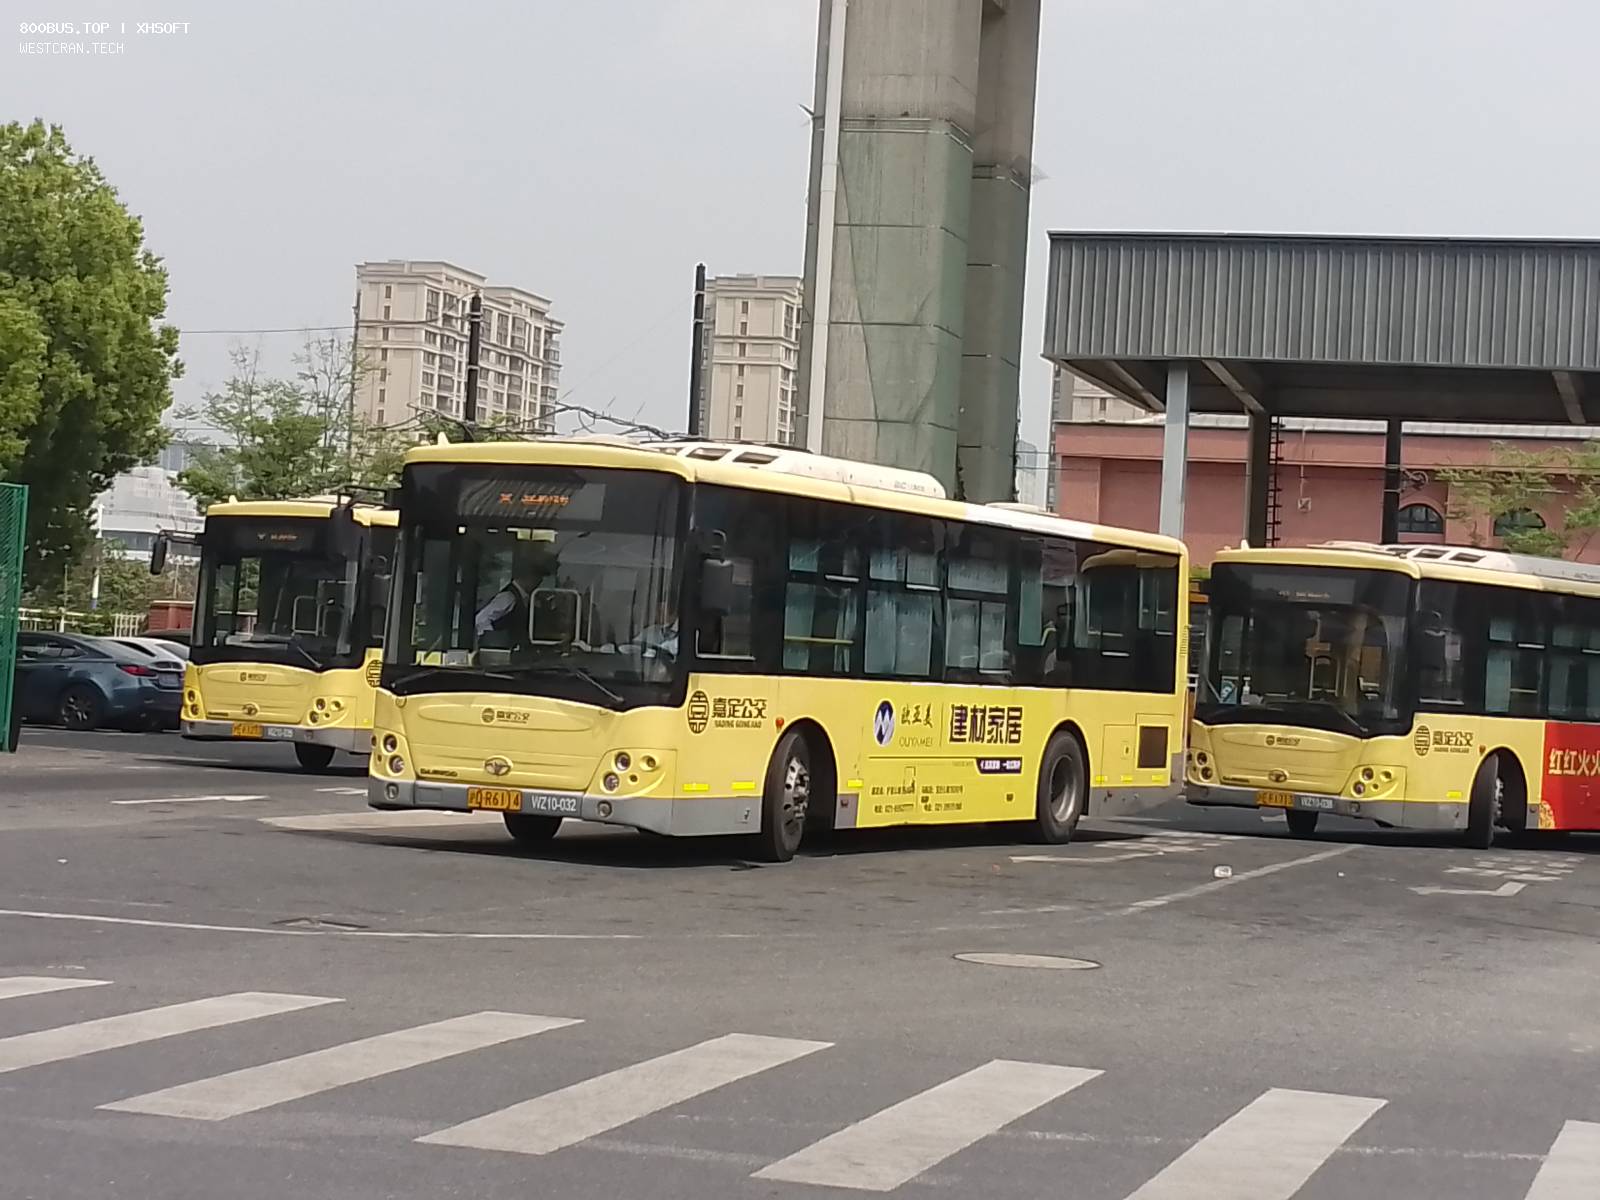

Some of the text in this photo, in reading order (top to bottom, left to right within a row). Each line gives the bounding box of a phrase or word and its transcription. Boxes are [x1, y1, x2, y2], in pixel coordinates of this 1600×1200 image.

[949, 704, 1023, 744] 建材家居
[531, 796, 577, 812] WZ10-032
